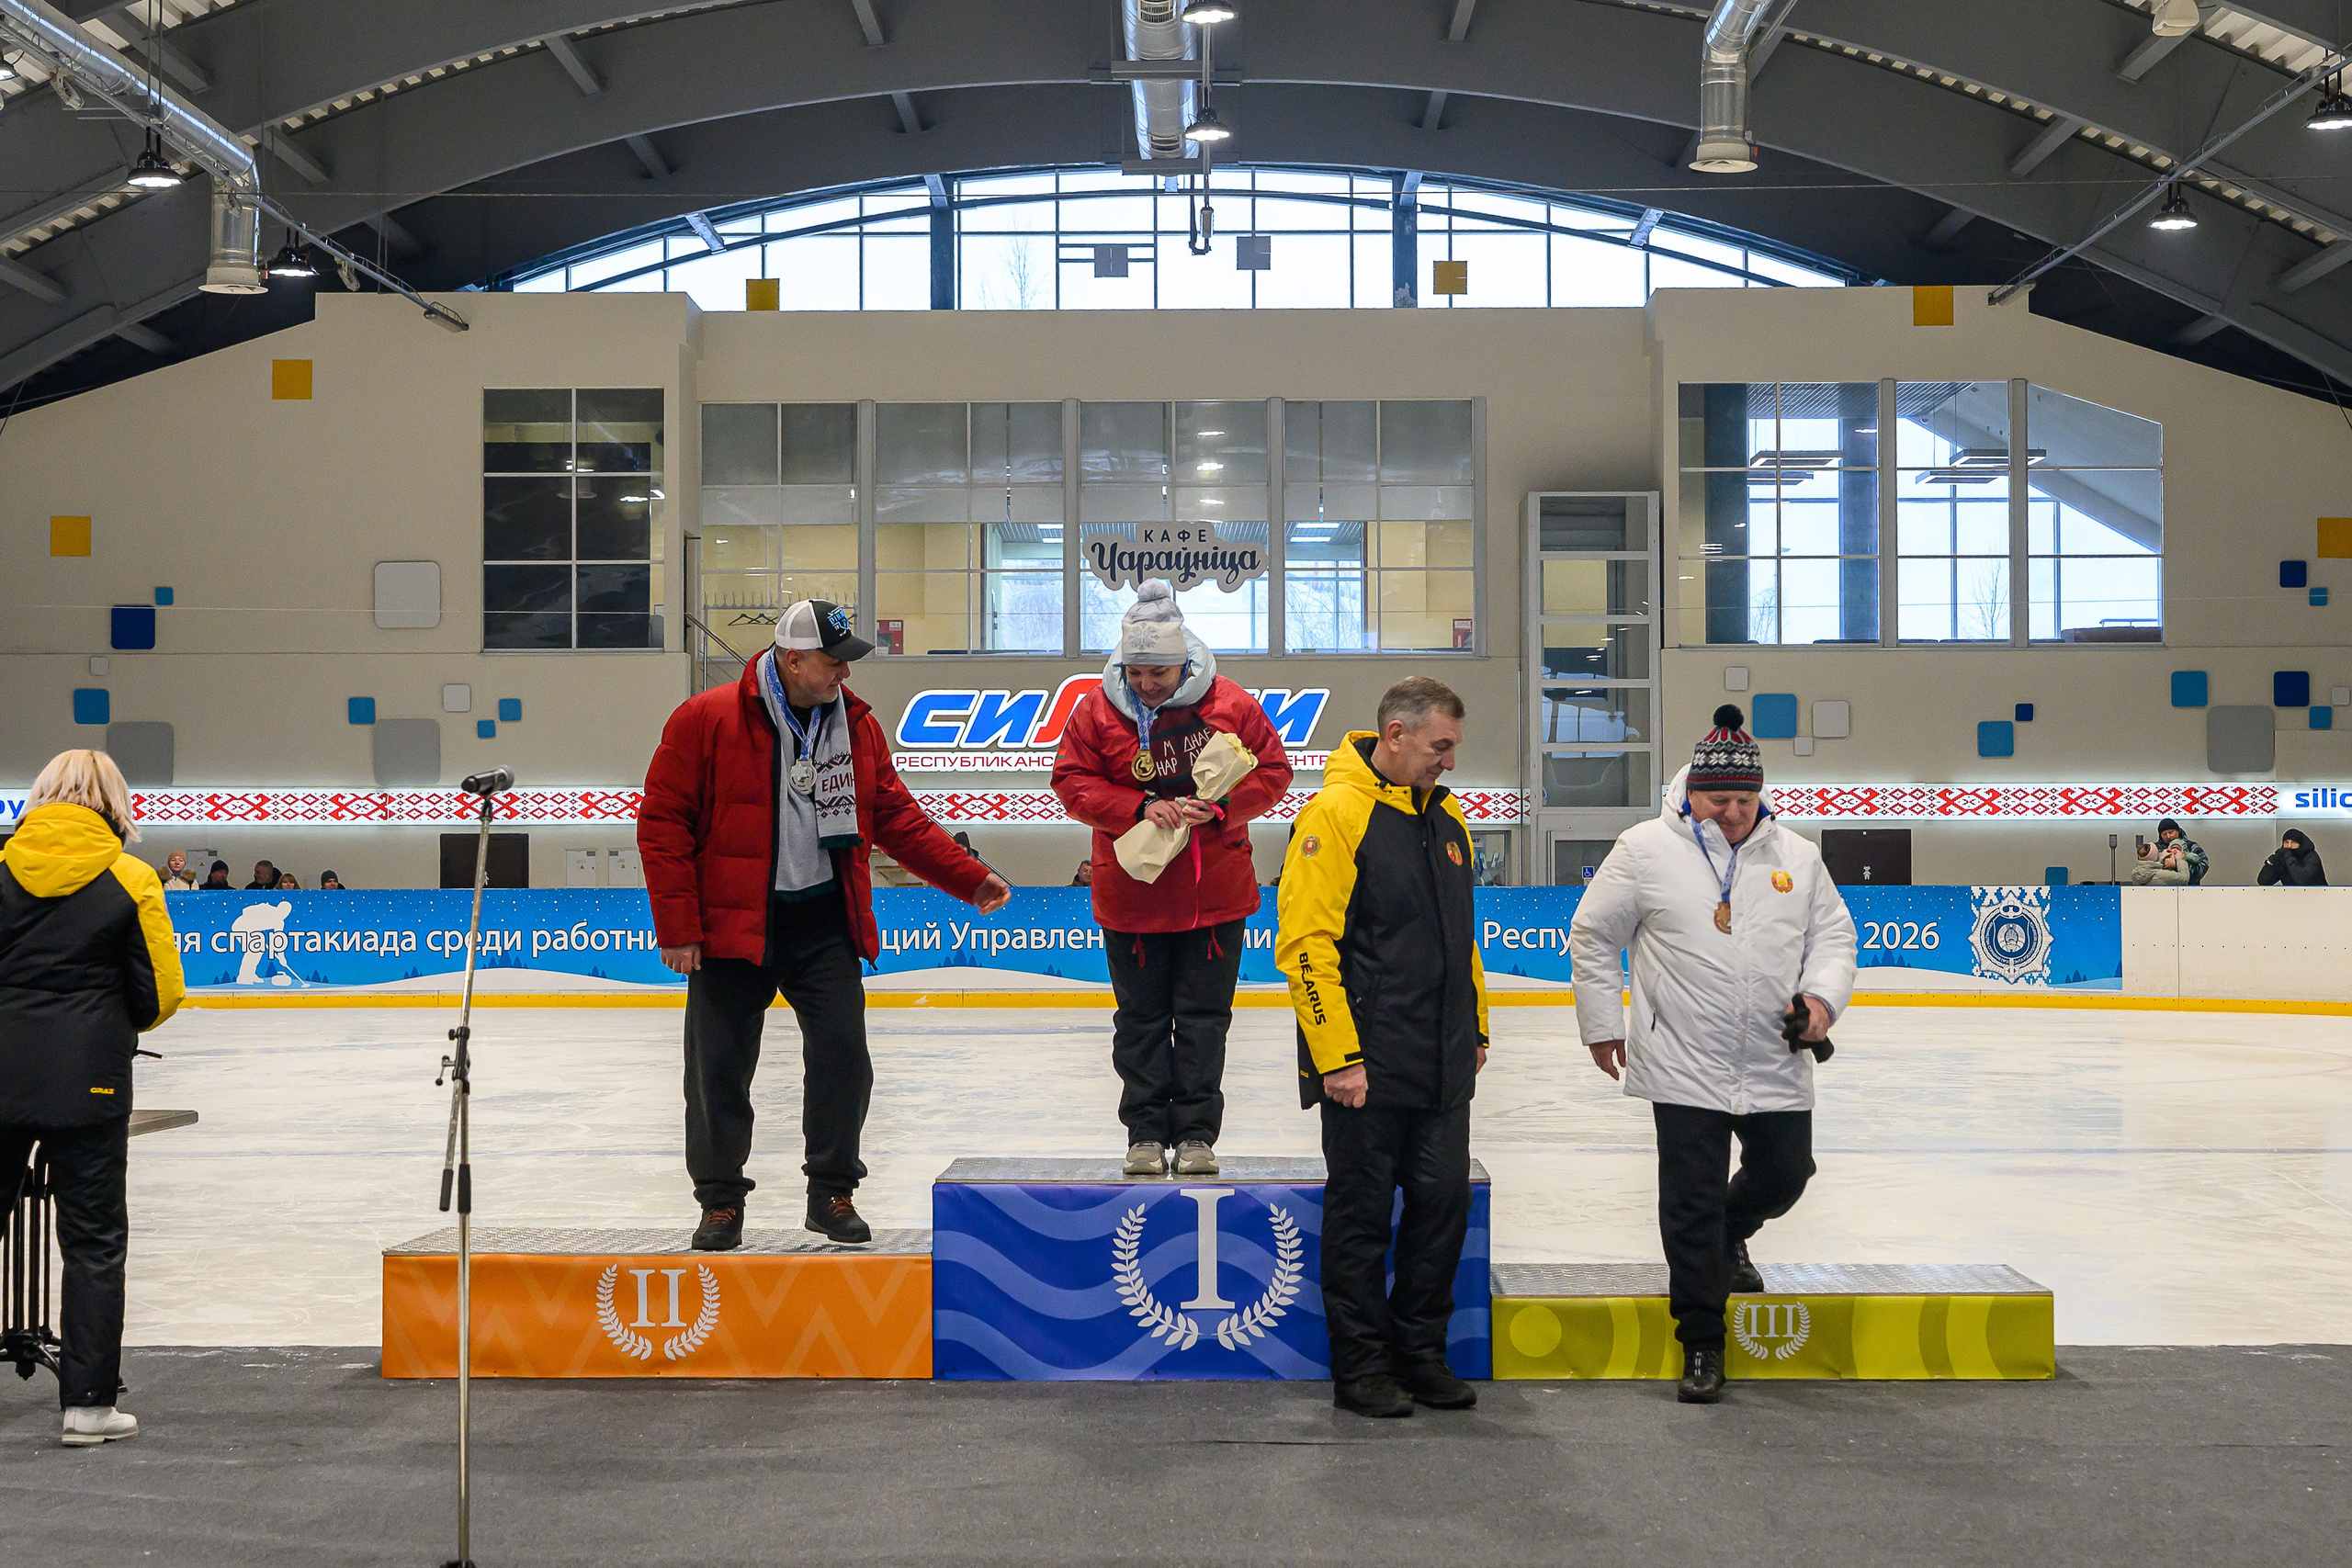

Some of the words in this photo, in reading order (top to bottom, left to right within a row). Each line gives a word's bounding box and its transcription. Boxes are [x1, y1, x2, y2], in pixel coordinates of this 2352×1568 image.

[1144, 529, 1206, 543] КАФЕ
[1091, 542, 1261, 585] Чараўніца
[210, 931, 416, 959] спартакиада
[425, 930, 522, 958] среди
[1862, 920, 1941, 951] 2026
[1298, 952, 1327, 1026] BELARUS
[628, 1269, 687, 1327] II
[1746, 1304, 1798, 1338] III
